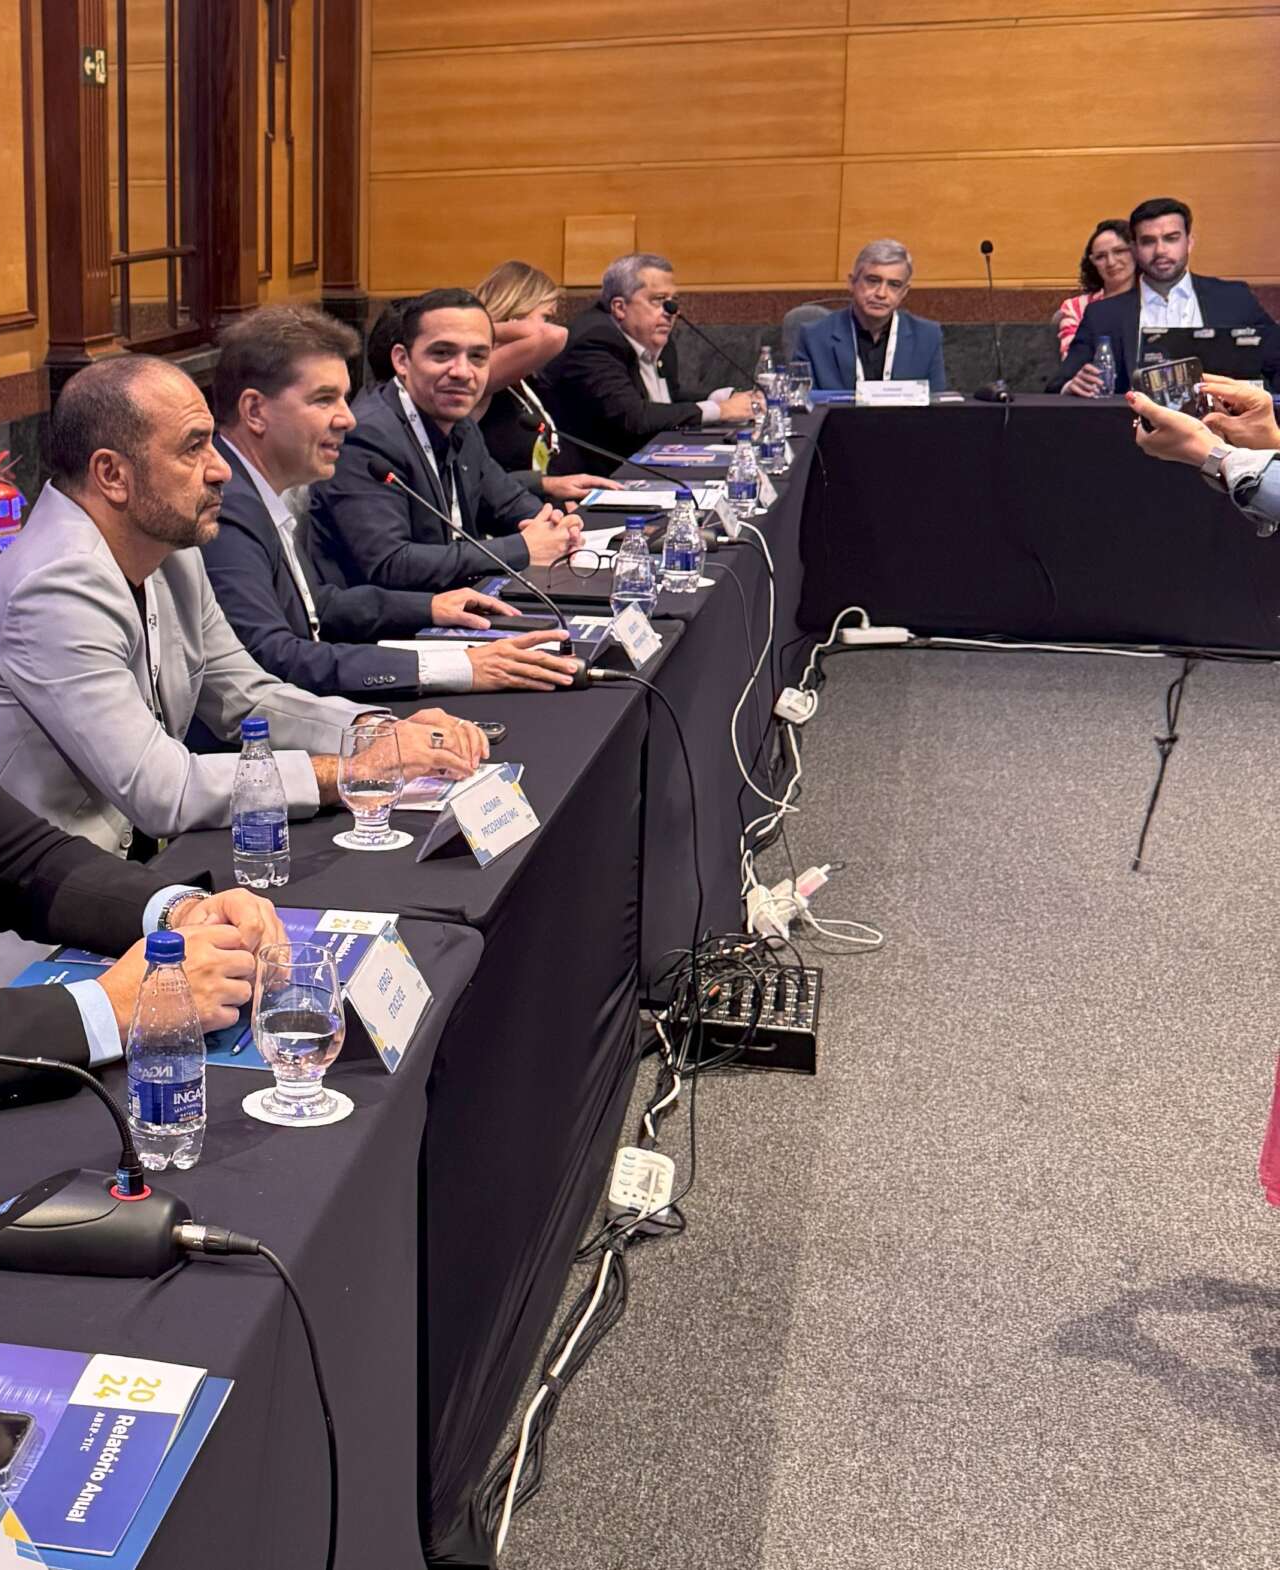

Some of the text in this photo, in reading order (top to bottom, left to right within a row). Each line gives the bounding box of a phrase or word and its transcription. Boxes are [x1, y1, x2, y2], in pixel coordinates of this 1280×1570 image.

[93, 1373, 128, 1400] 24
[128, 1376, 162, 1403] 20
[65, 1414, 136, 1523] Relatório Anual
